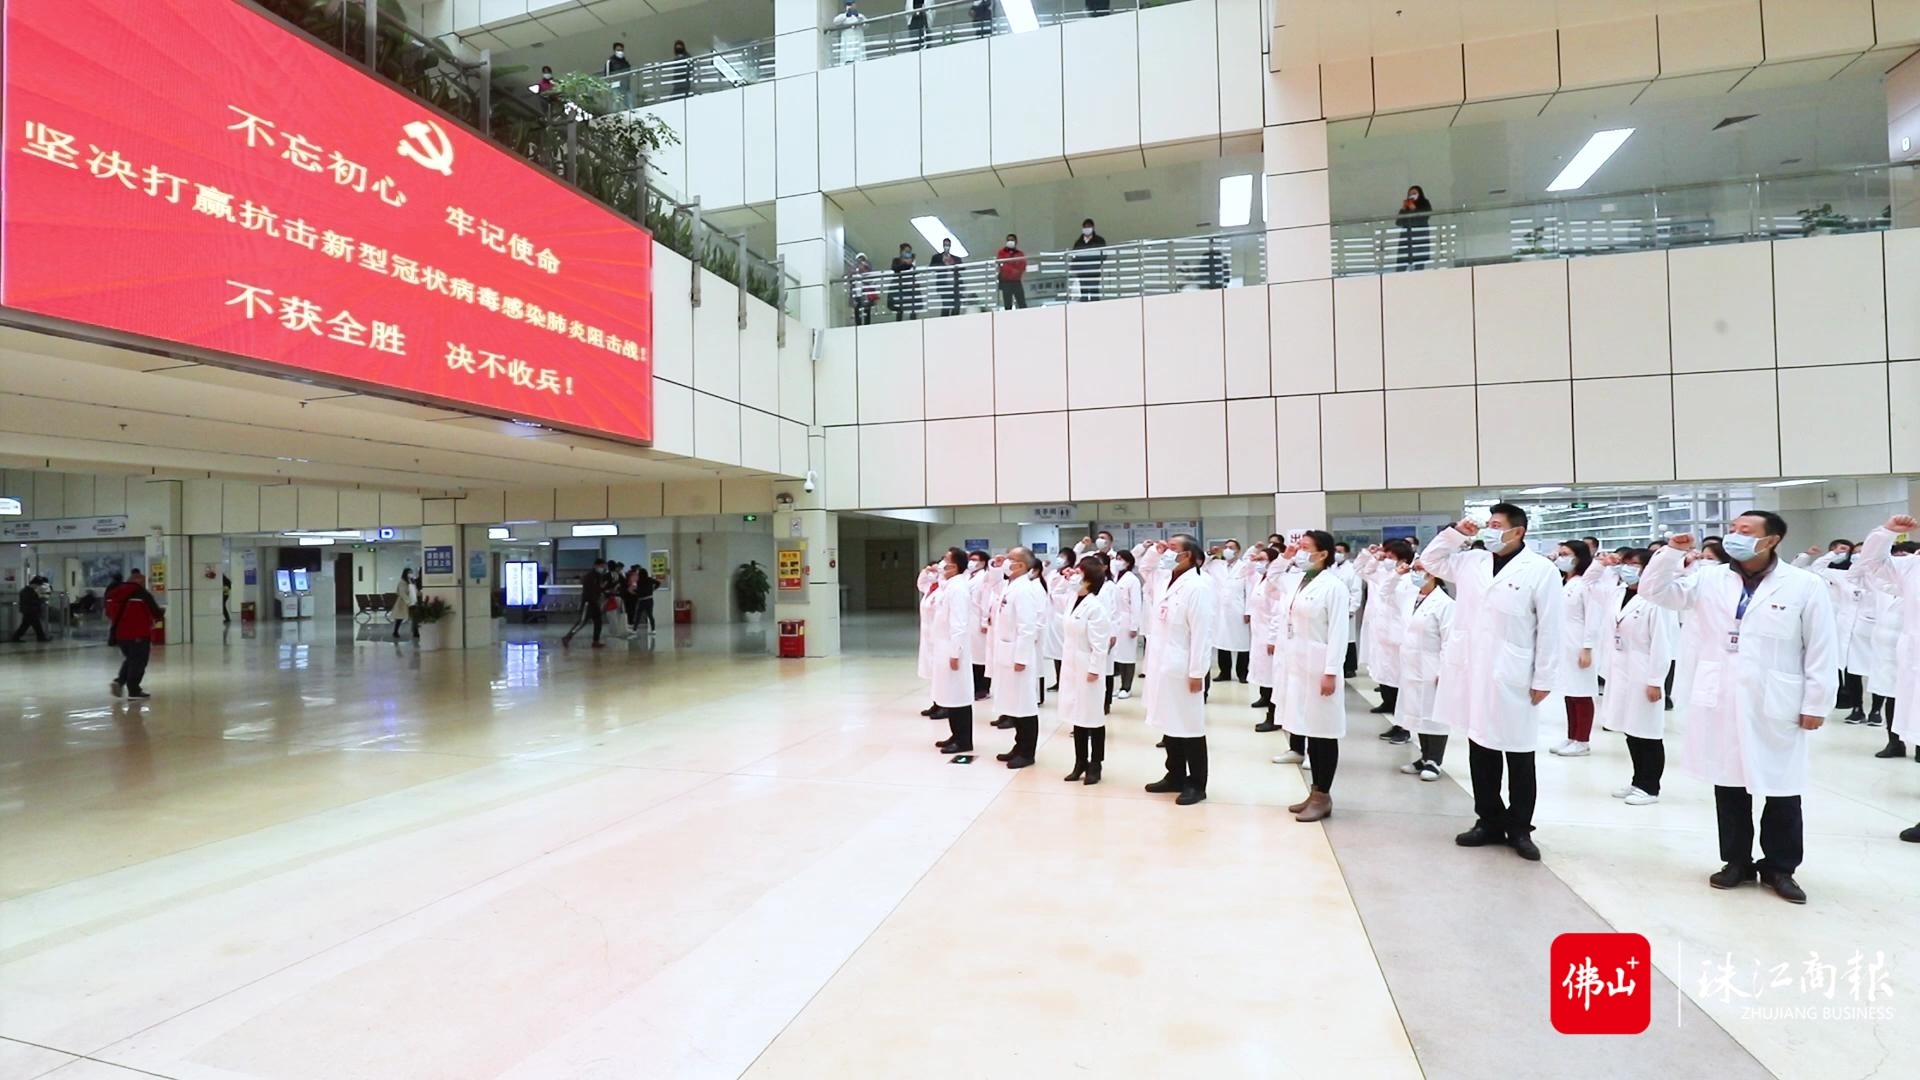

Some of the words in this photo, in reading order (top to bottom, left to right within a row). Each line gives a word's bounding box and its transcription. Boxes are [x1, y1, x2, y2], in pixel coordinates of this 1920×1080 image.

[21, 120, 647, 362] 坚决打赢抗击新型冠状病毒感染肺炎阻击战!
[226, 104, 408, 208] 不忘初心
[444, 206, 561, 274] 牢记使命
[225, 280, 407, 356] 不获全胜
[444, 341, 574, 395] 决不收兵!
